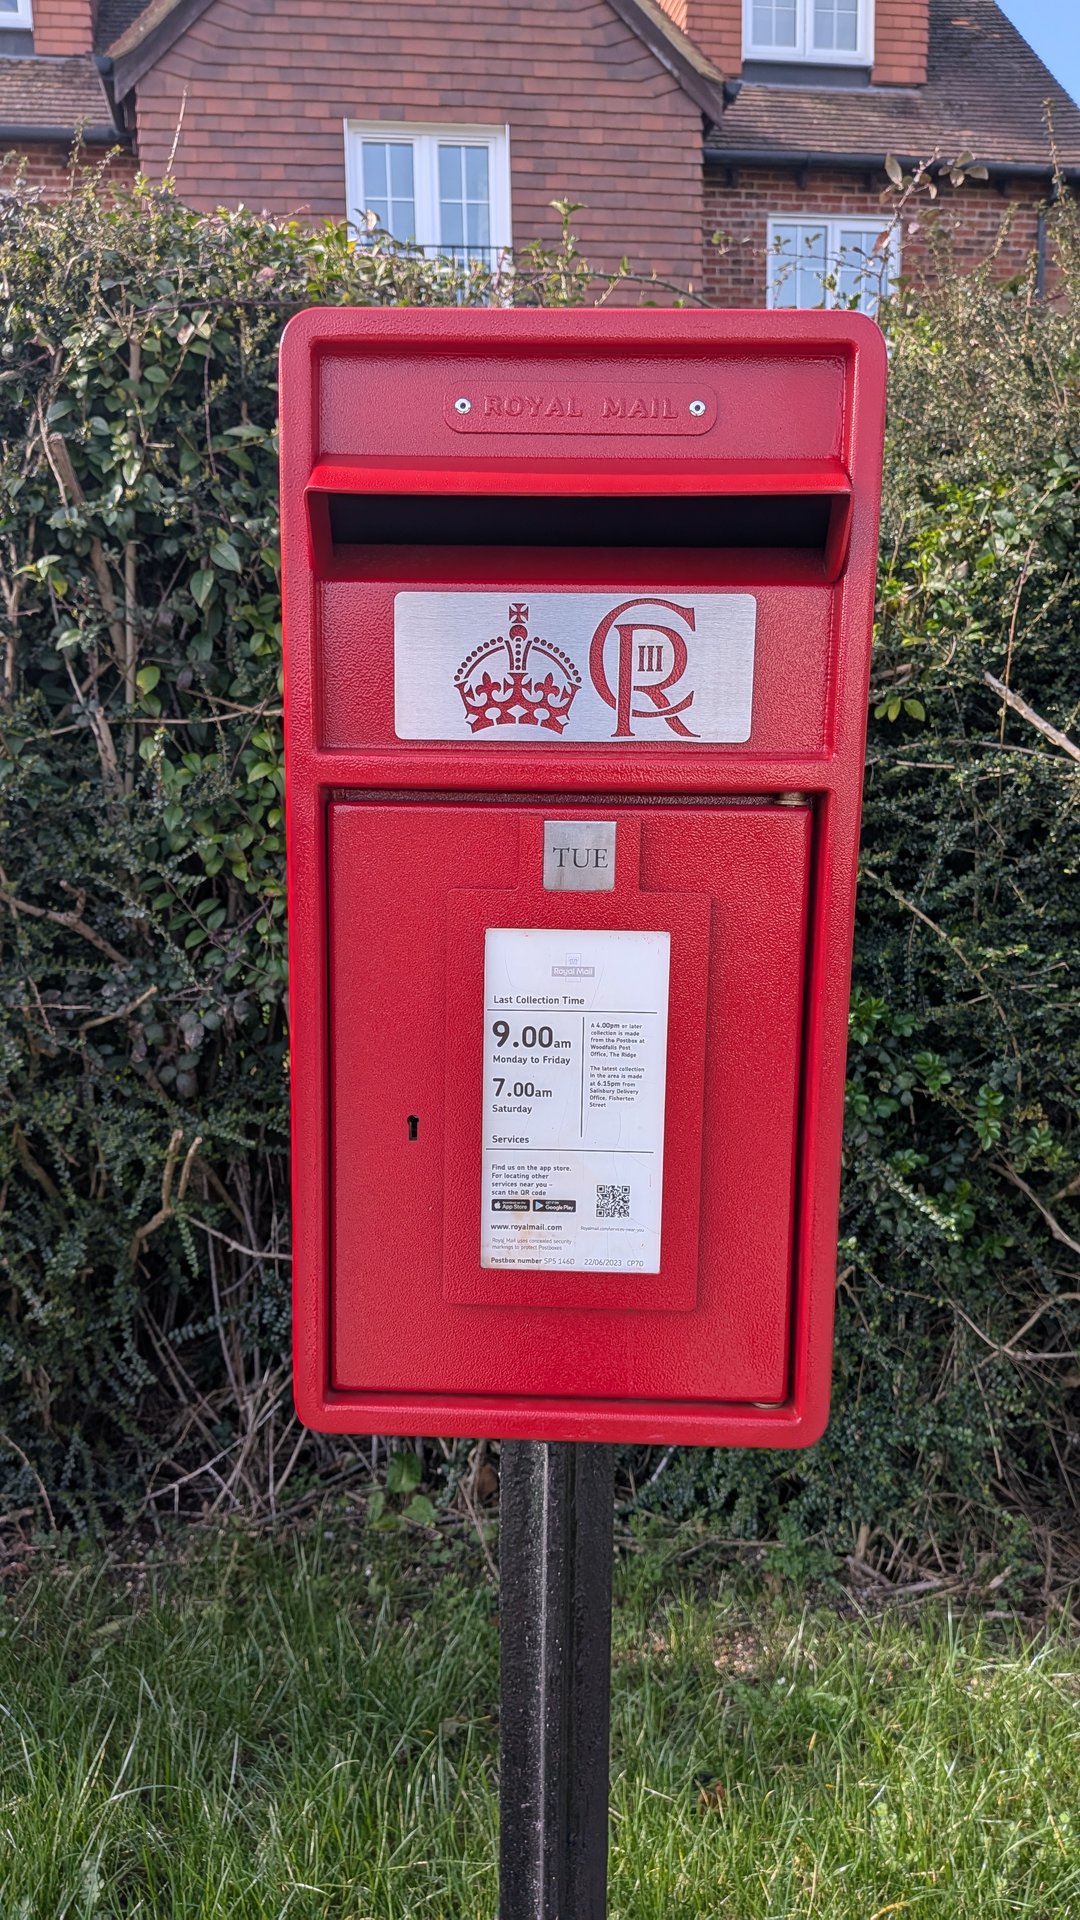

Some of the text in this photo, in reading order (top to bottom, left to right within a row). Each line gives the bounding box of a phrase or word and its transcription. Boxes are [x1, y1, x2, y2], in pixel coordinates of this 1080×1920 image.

[484, 395, 679, 419] ROYAL MAIL
[552, 847, 608, 868] TUE
[553, 967, 593, 976] Royal Mail
[493, 995, 585, 1005] Last Collection Time
[492, 1020, 571, 1048] 9.00am
[493, 1054, 571, 1066] Monday to Friday
[492, 1077, 553, 1098] 7.00am
[492, 1104, 533, 1115] Saturday
[492, 1135, 530, 1144] Services
